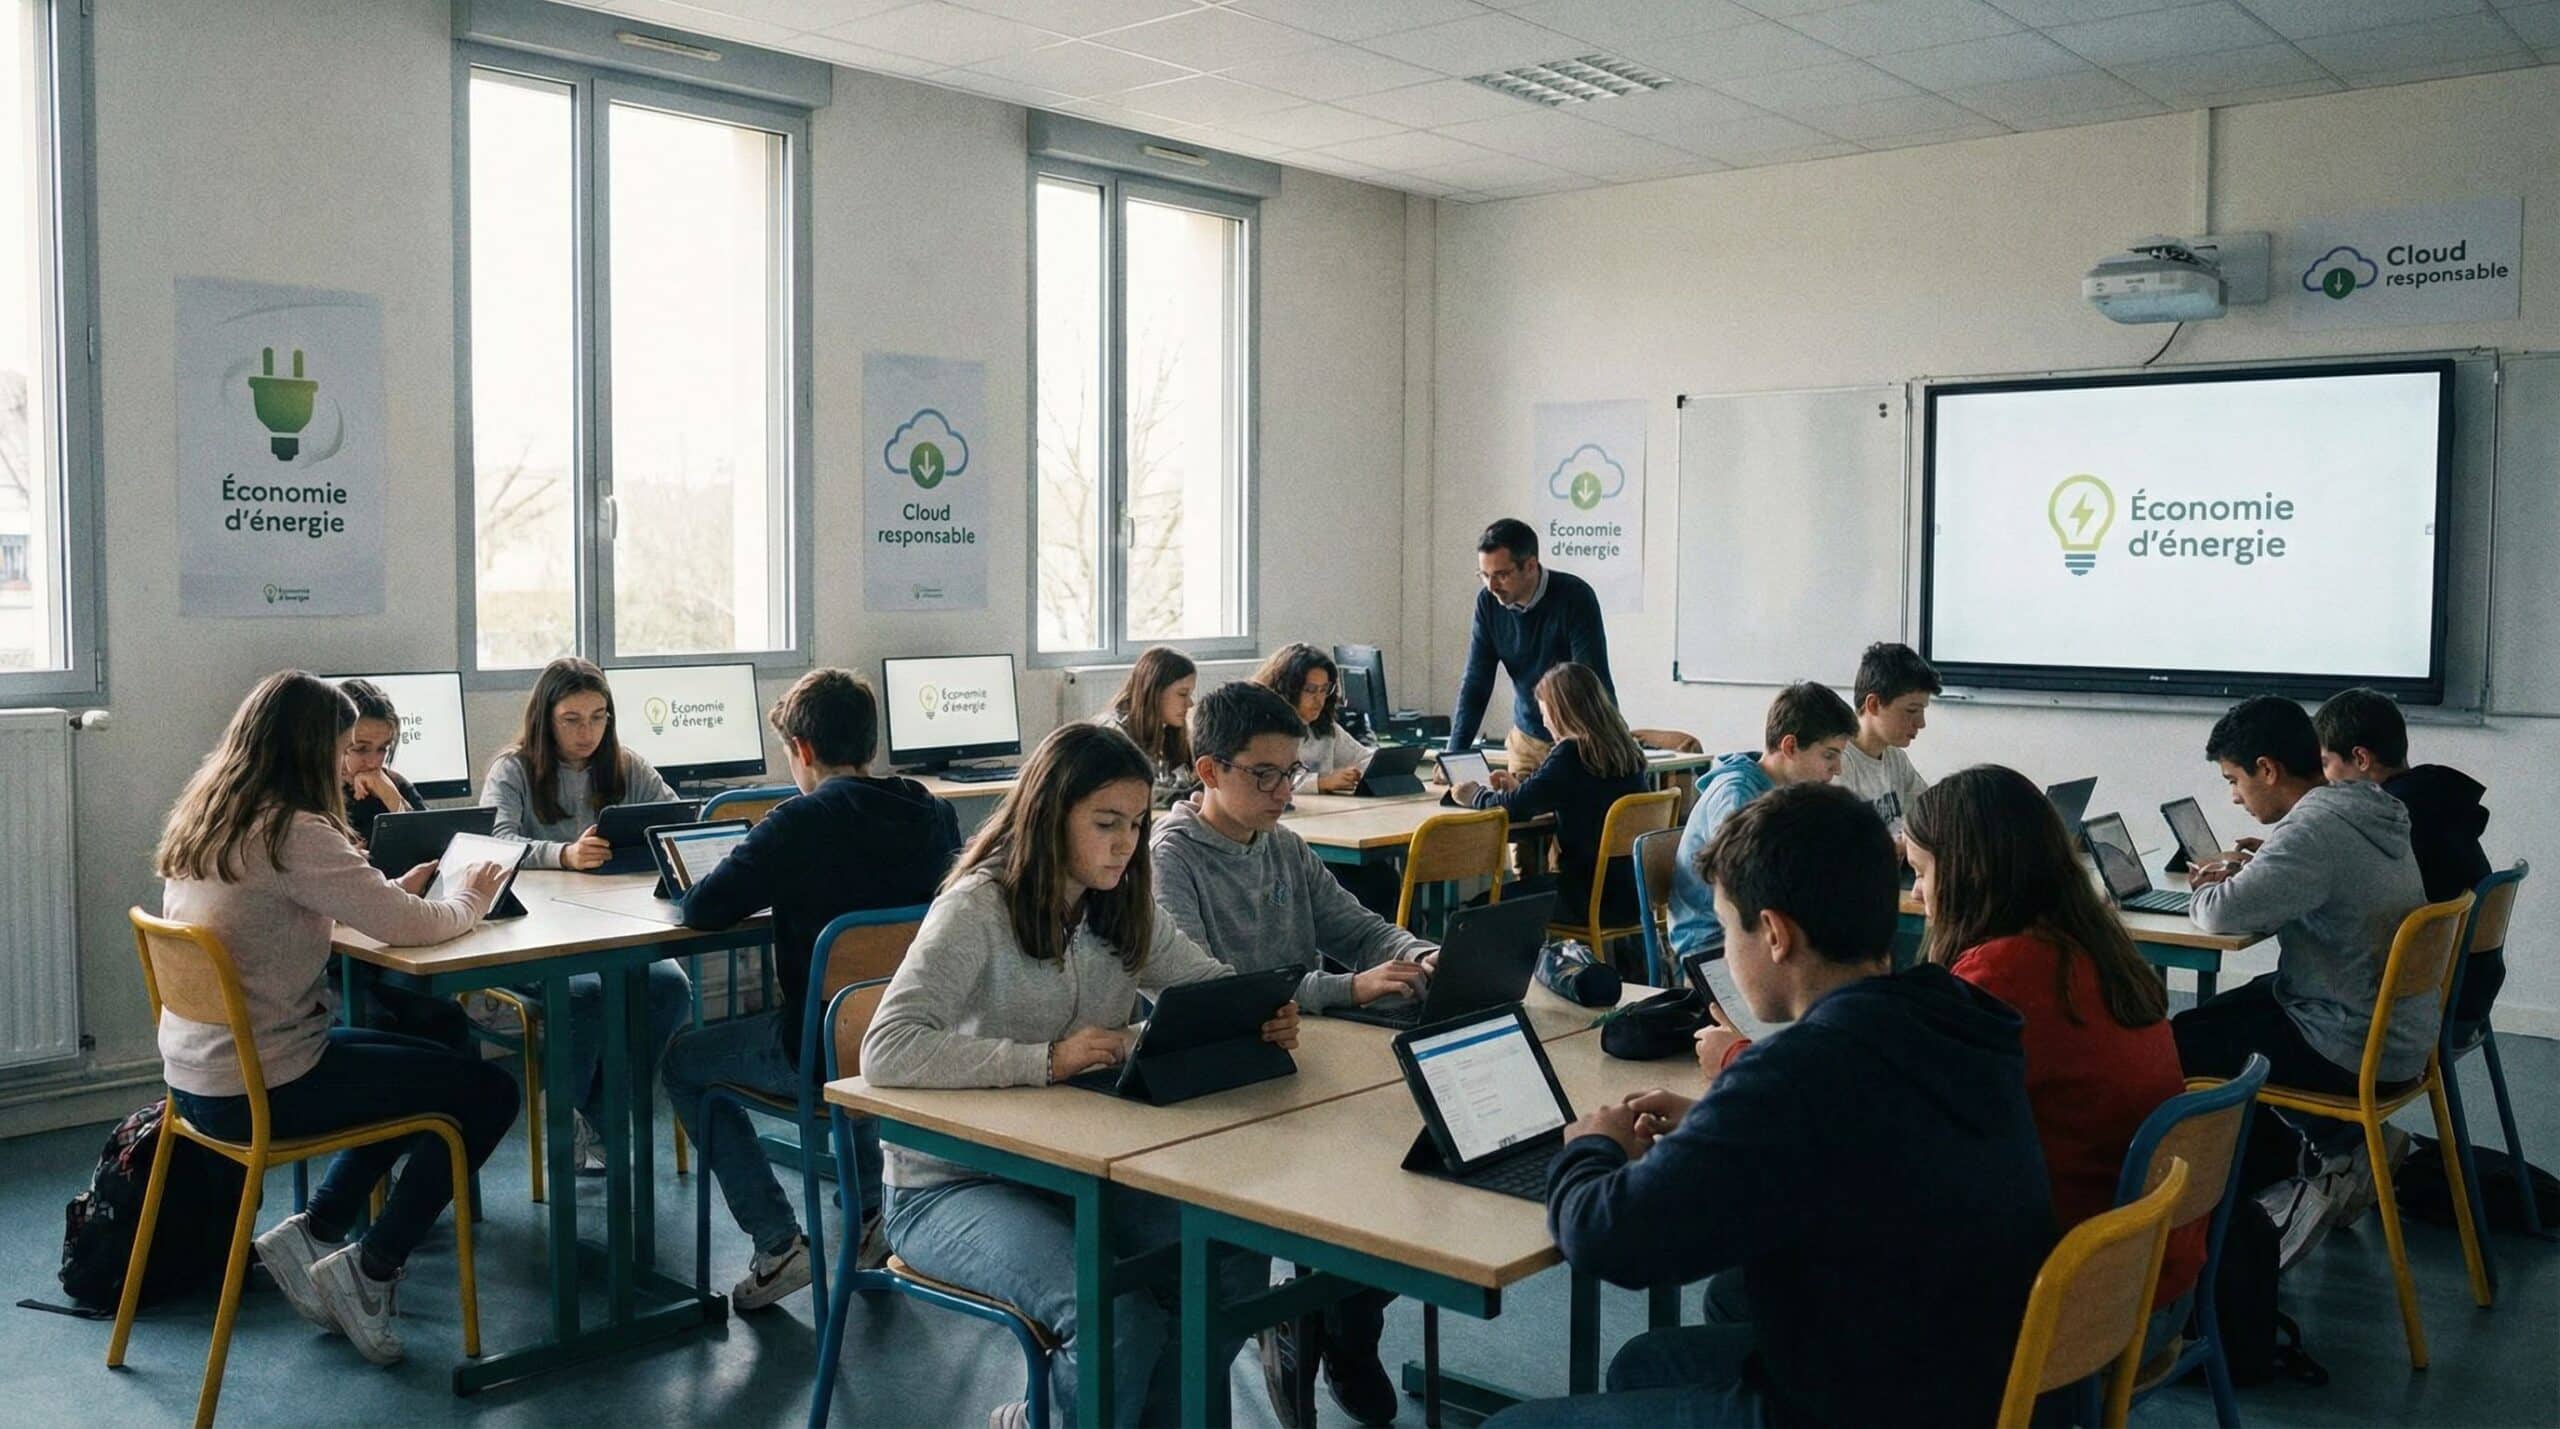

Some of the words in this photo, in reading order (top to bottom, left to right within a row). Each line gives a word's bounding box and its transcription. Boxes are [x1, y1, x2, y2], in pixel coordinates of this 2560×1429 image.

[2386, 239, 2467, 267] Cloud
[2386, 262, 2509, 289] responsable
[222, 473, 347, 505] Économie
[903, 503, 951, 521] Cloud
[2131, 488, 2295, 522] Économie
[225, 508, 345, 538] d'énergie
[1550, 519, 1622, 537] Économie
[878, 526, 976, 548] responsable
[2128, 529, 2287, 566] d'énergie
[1551, 542, 1620, 561] d'énergie
